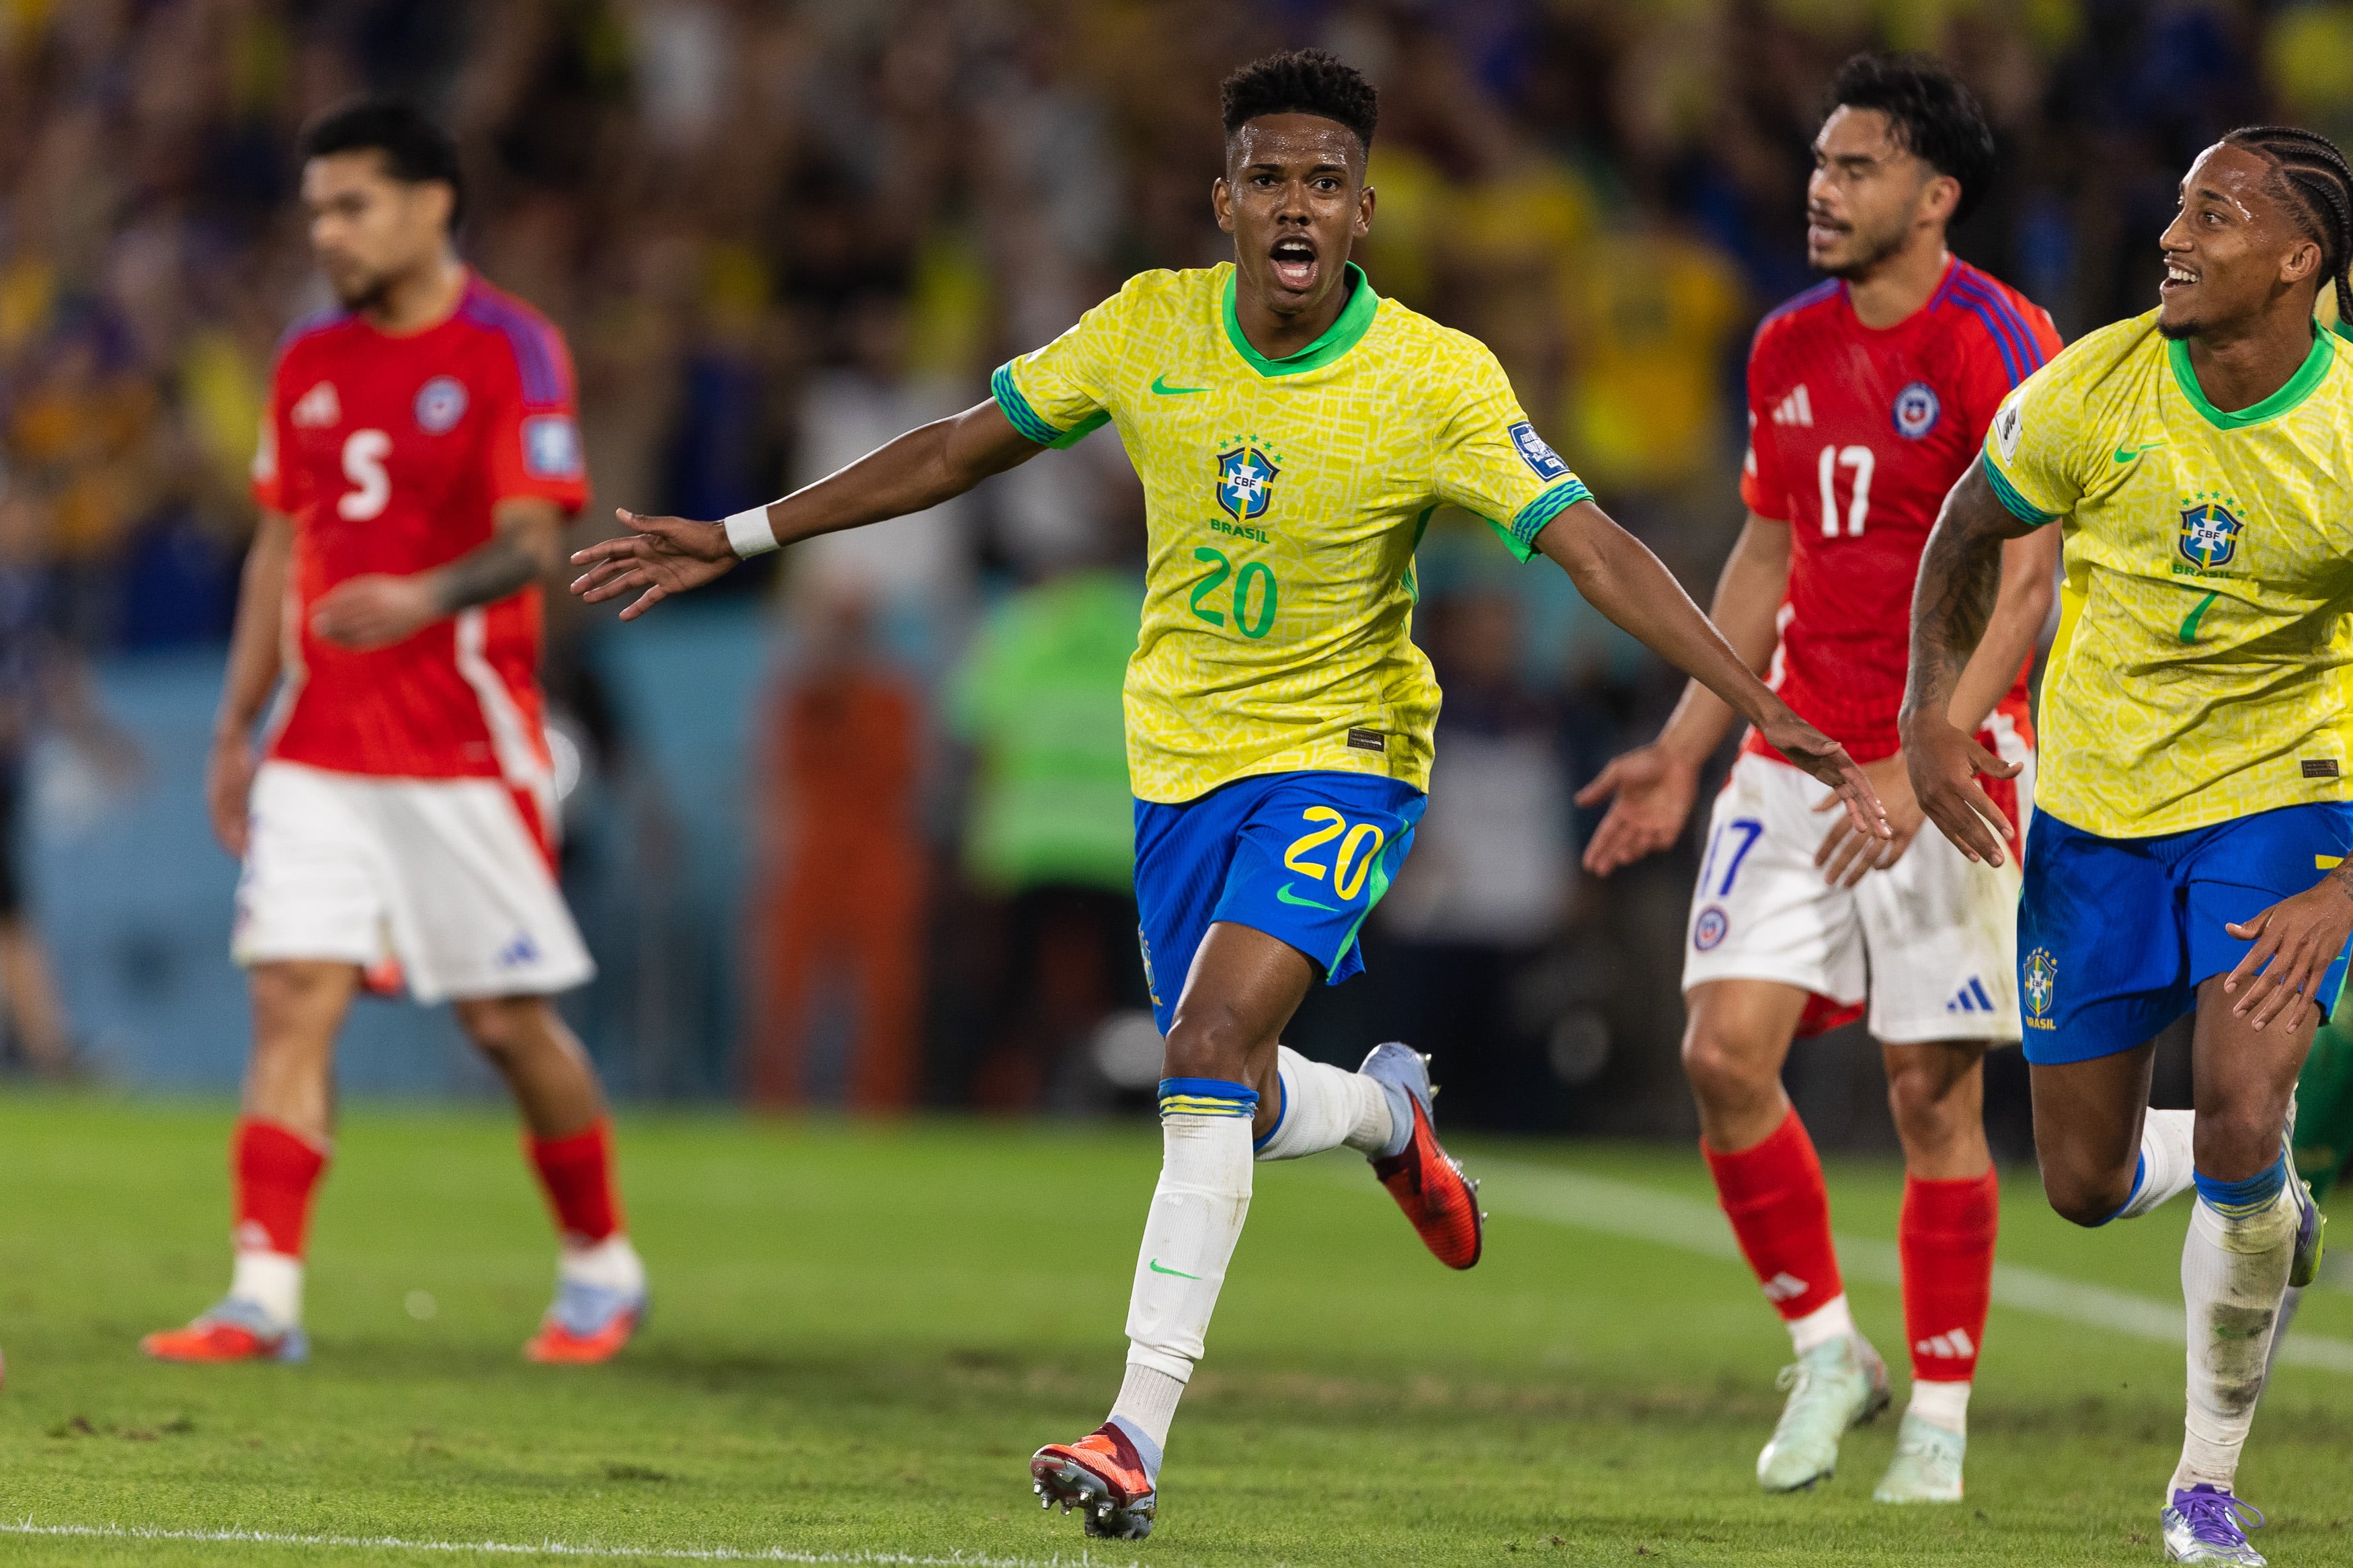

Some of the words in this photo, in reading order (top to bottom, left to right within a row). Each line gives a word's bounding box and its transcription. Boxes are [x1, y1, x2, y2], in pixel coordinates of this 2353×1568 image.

[337, 427, 391, 522] 5
[1234, 476, 1257, 488] CBF
[1818, 444, 1876, 537] 17
[1210, 518, 1270, 544] BRASIL
[2198, 529, 2221, 540] CBF
[1189, 546, 1278, 639] 20
[1283, 805, 1384, 901] 20
